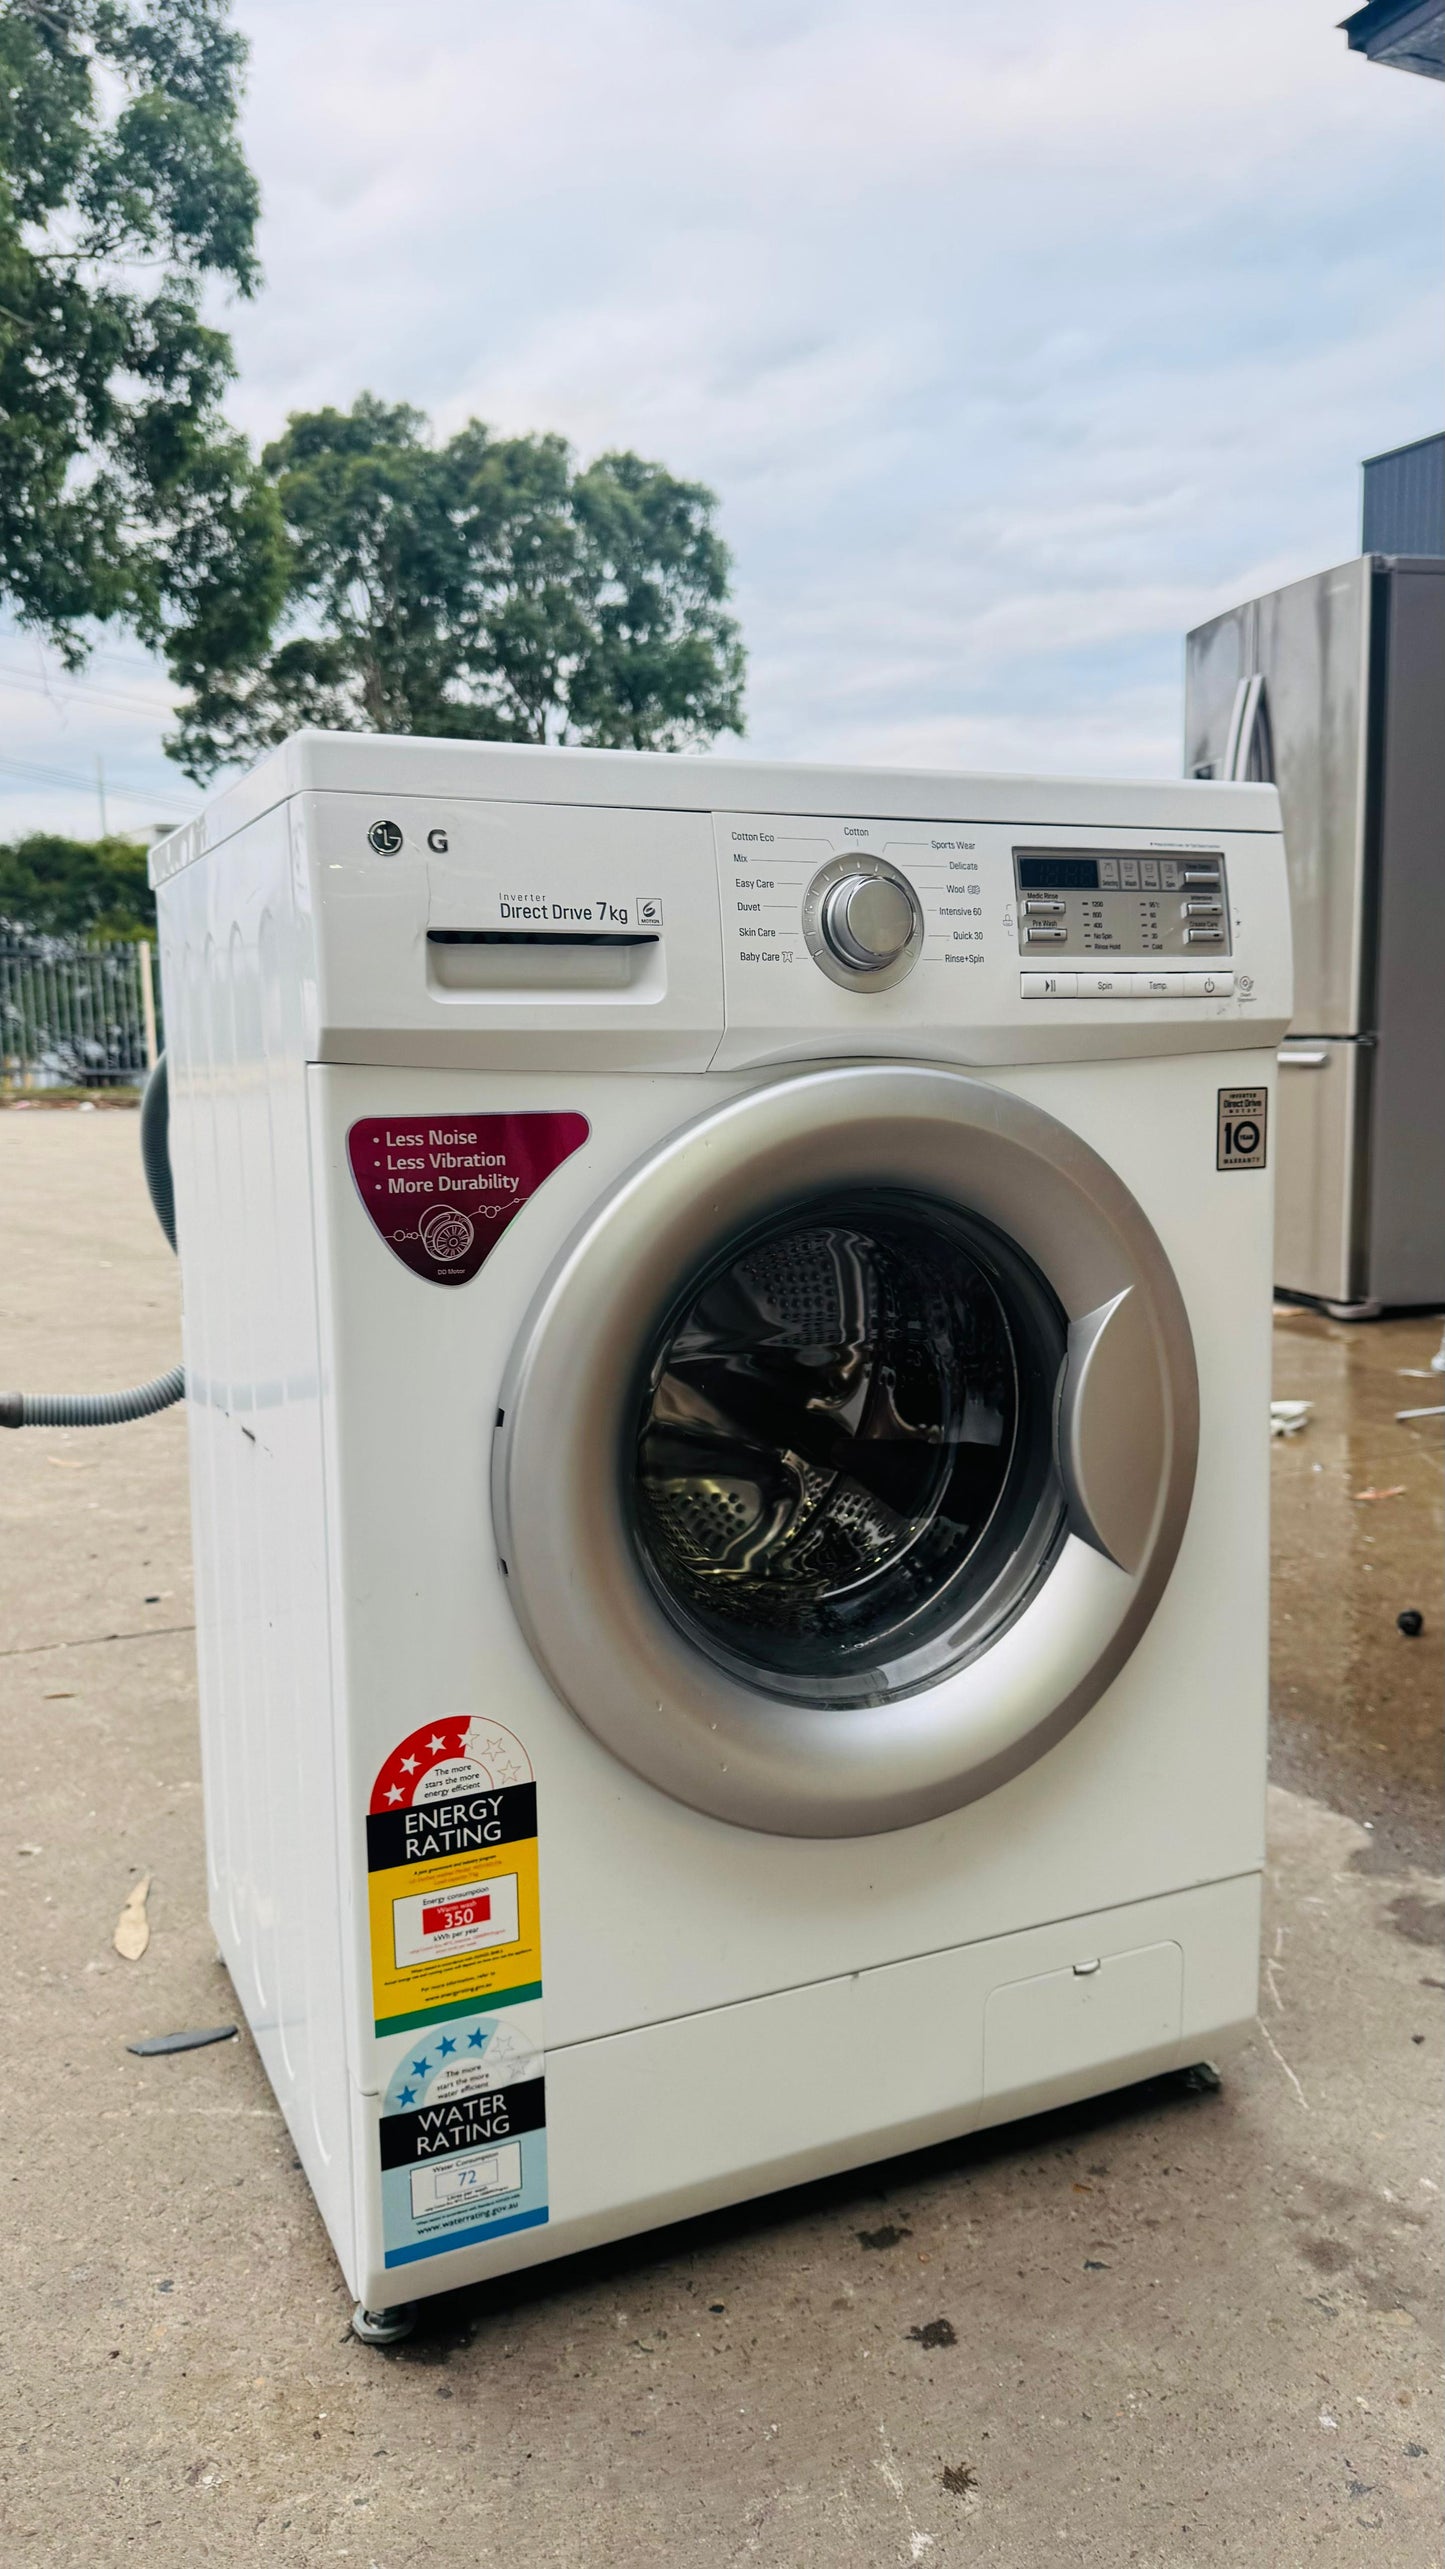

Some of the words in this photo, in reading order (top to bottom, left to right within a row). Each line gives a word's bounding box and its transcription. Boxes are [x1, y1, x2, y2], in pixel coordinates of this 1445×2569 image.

[731, 831, 758, 841] Cotton
[760, 832, 774, 842] Eco
[843, 827, 869, 837] Cotton
[427, 829, 448, 853] G
[931, 840, 955, 850] Sports
[956, 841, 975, 850] Wear
[733, 854, 748, 863] Mix
[949, 861, 978, 871] Delicate
[735, 878, 754, 890] Easy
[756, 880, 774, 888] Care
[946, 884, 965, 894] Wool
[498, 892, 546, 902] Inverter
[1027, 892, 1043, 900] Medic
[500, 902, 548, 920] Direct
[552, 904, 592, 920] Drive
[737, 902, 761, 912] Duvet
[939, 907, 972, 916] Intensive
[973, 907, 982, 916] 60
[739, 927, 756, 937] Skin
[758, 928, 776, 937] Care
[953, 931, 973, 941] Quick
[974, 932, 984, 941] 30
[1102, 933, 1112, 941] Spin
[740, 951, 760, 963] Baby
[762, 952, 780, 962] Care
[945, 954, 985, 964] Rinse+Spin
[1097, 981, 1113, 991] Spin
[1223, 1100, 1244, 1108] Direct
[1244, 1099, 1262, 1107] Drive
[386, 1131, 424, 1147] Less
[428, 1129, 478, 1146] Noise
[1224, 1121, 1260, 1154] 10
[387, 1154, 425, 1170] Less
[429, 1151, 507, 1169] Vibration
[388, 1178, 434, 1194] More
[438, 1173, 520, 1193] Durability
[434, 1768, 449, 1776] The
[451, 1764, 472, 1774] more
[425, 1781, 443, 1789] stars
[445, 1777, 458, 1785] the
[460, 1773, 480, 1782] more
[424, 1789, 450, 1798] energy
[451, 1782, 480, 1792] efficient
[405, 1796, 504, 1835] ENERGY
[406, 1821, 502, 1859] RATING
[422, 1896, 445, 1906] Energy
[447, 1886, 489, 1901] consumption
[436, 1904, 459, 1914] Warm
[460, 1900, 477, 1909] wash
[444, 1908, 474, 1929] 350
[433, 1933, 450, 1941] kWh
[452, 1931, 462, 1939] per
[465, 1927, 479, 1936] year
[446, 2070, 460, 2078] The
[461, 2064, 481, 2073] more
[437, 2082, 454, 2091] stars
[456, 2077, 467, 2085] the
[469, 2073, 489, 2081] more
[438, 2090, 458, 2099] water
[461, 2082, 488, 2093] efficient
[418, 2094, 507, 2132] WATER
[417, 2115, 510, 2155] RATING
[433, 2164, 454, 2173] Water
[456, 2151, 499, 2167] Consumption
[458, 2169, 477, 2186] 72
[416, 2202, 519, 2235] www.waterrating.gov.au
